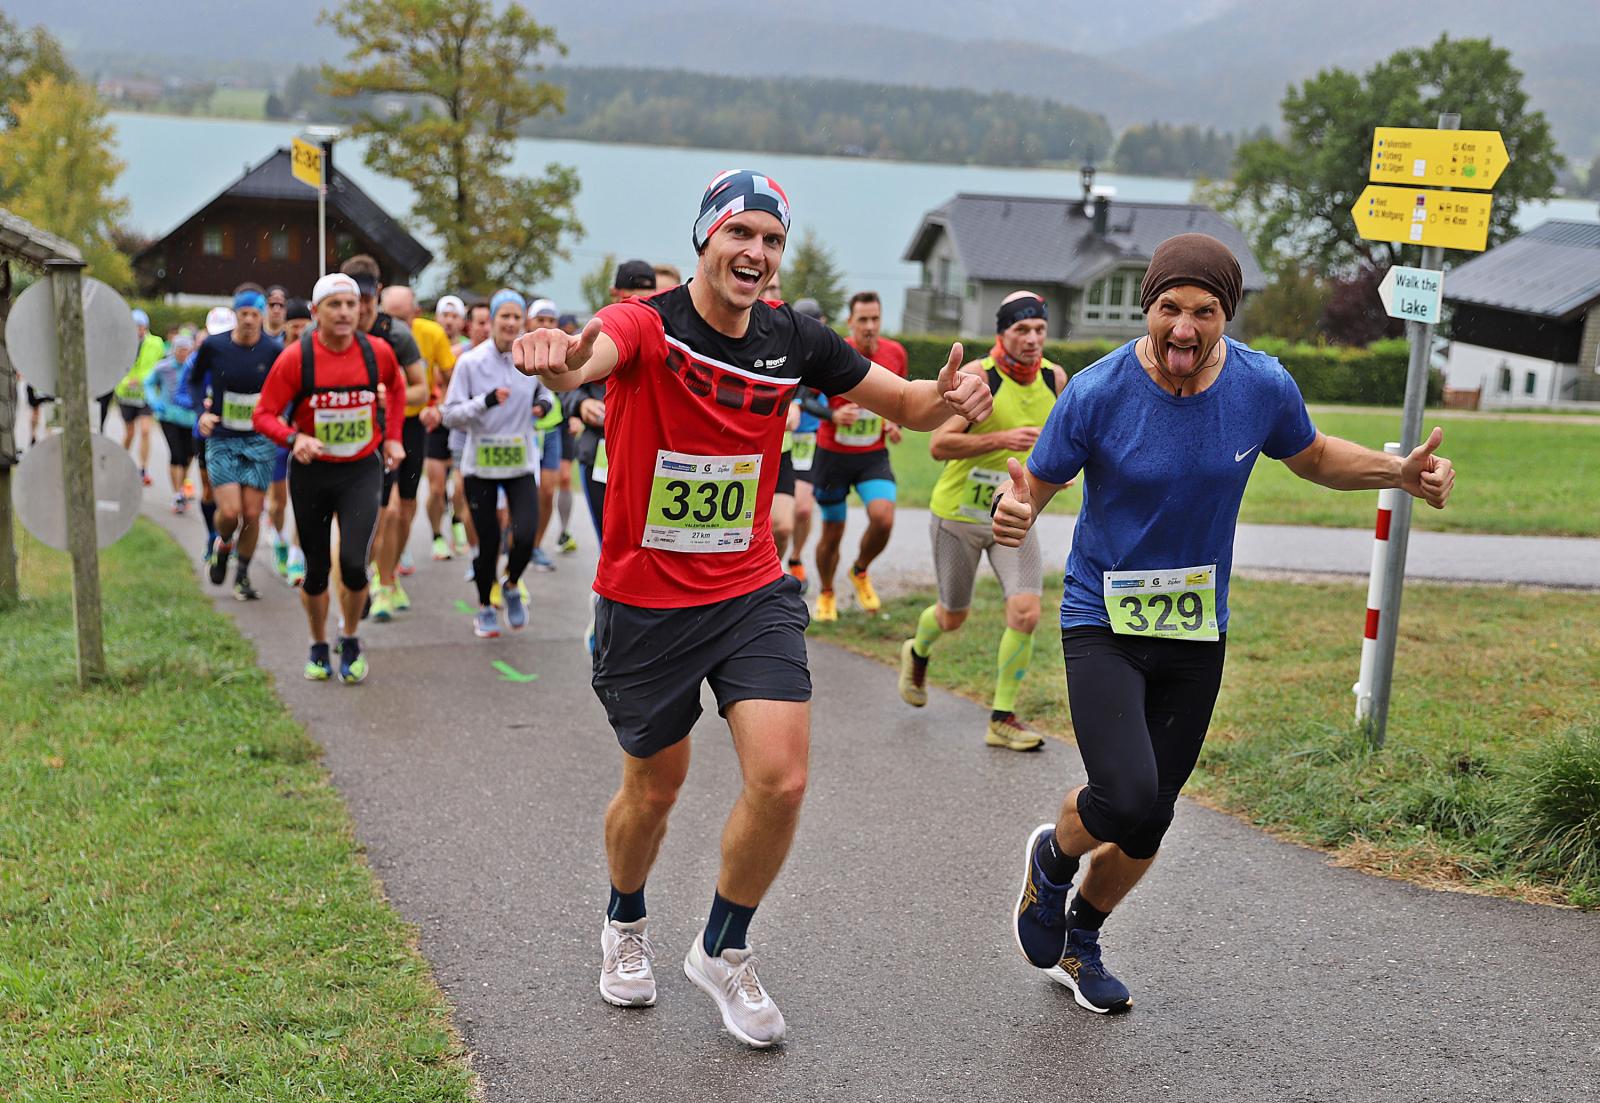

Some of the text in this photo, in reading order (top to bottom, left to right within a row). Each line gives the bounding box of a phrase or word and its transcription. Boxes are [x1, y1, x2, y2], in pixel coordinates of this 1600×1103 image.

[1396, 273, 1437, 292] Walk the
[1401, 298, 1427, 316] Lake
[323, 420, 366, 442] 1248
[661, 480, 745, 522] 330
[1119, 592, 1203, 631] 329
